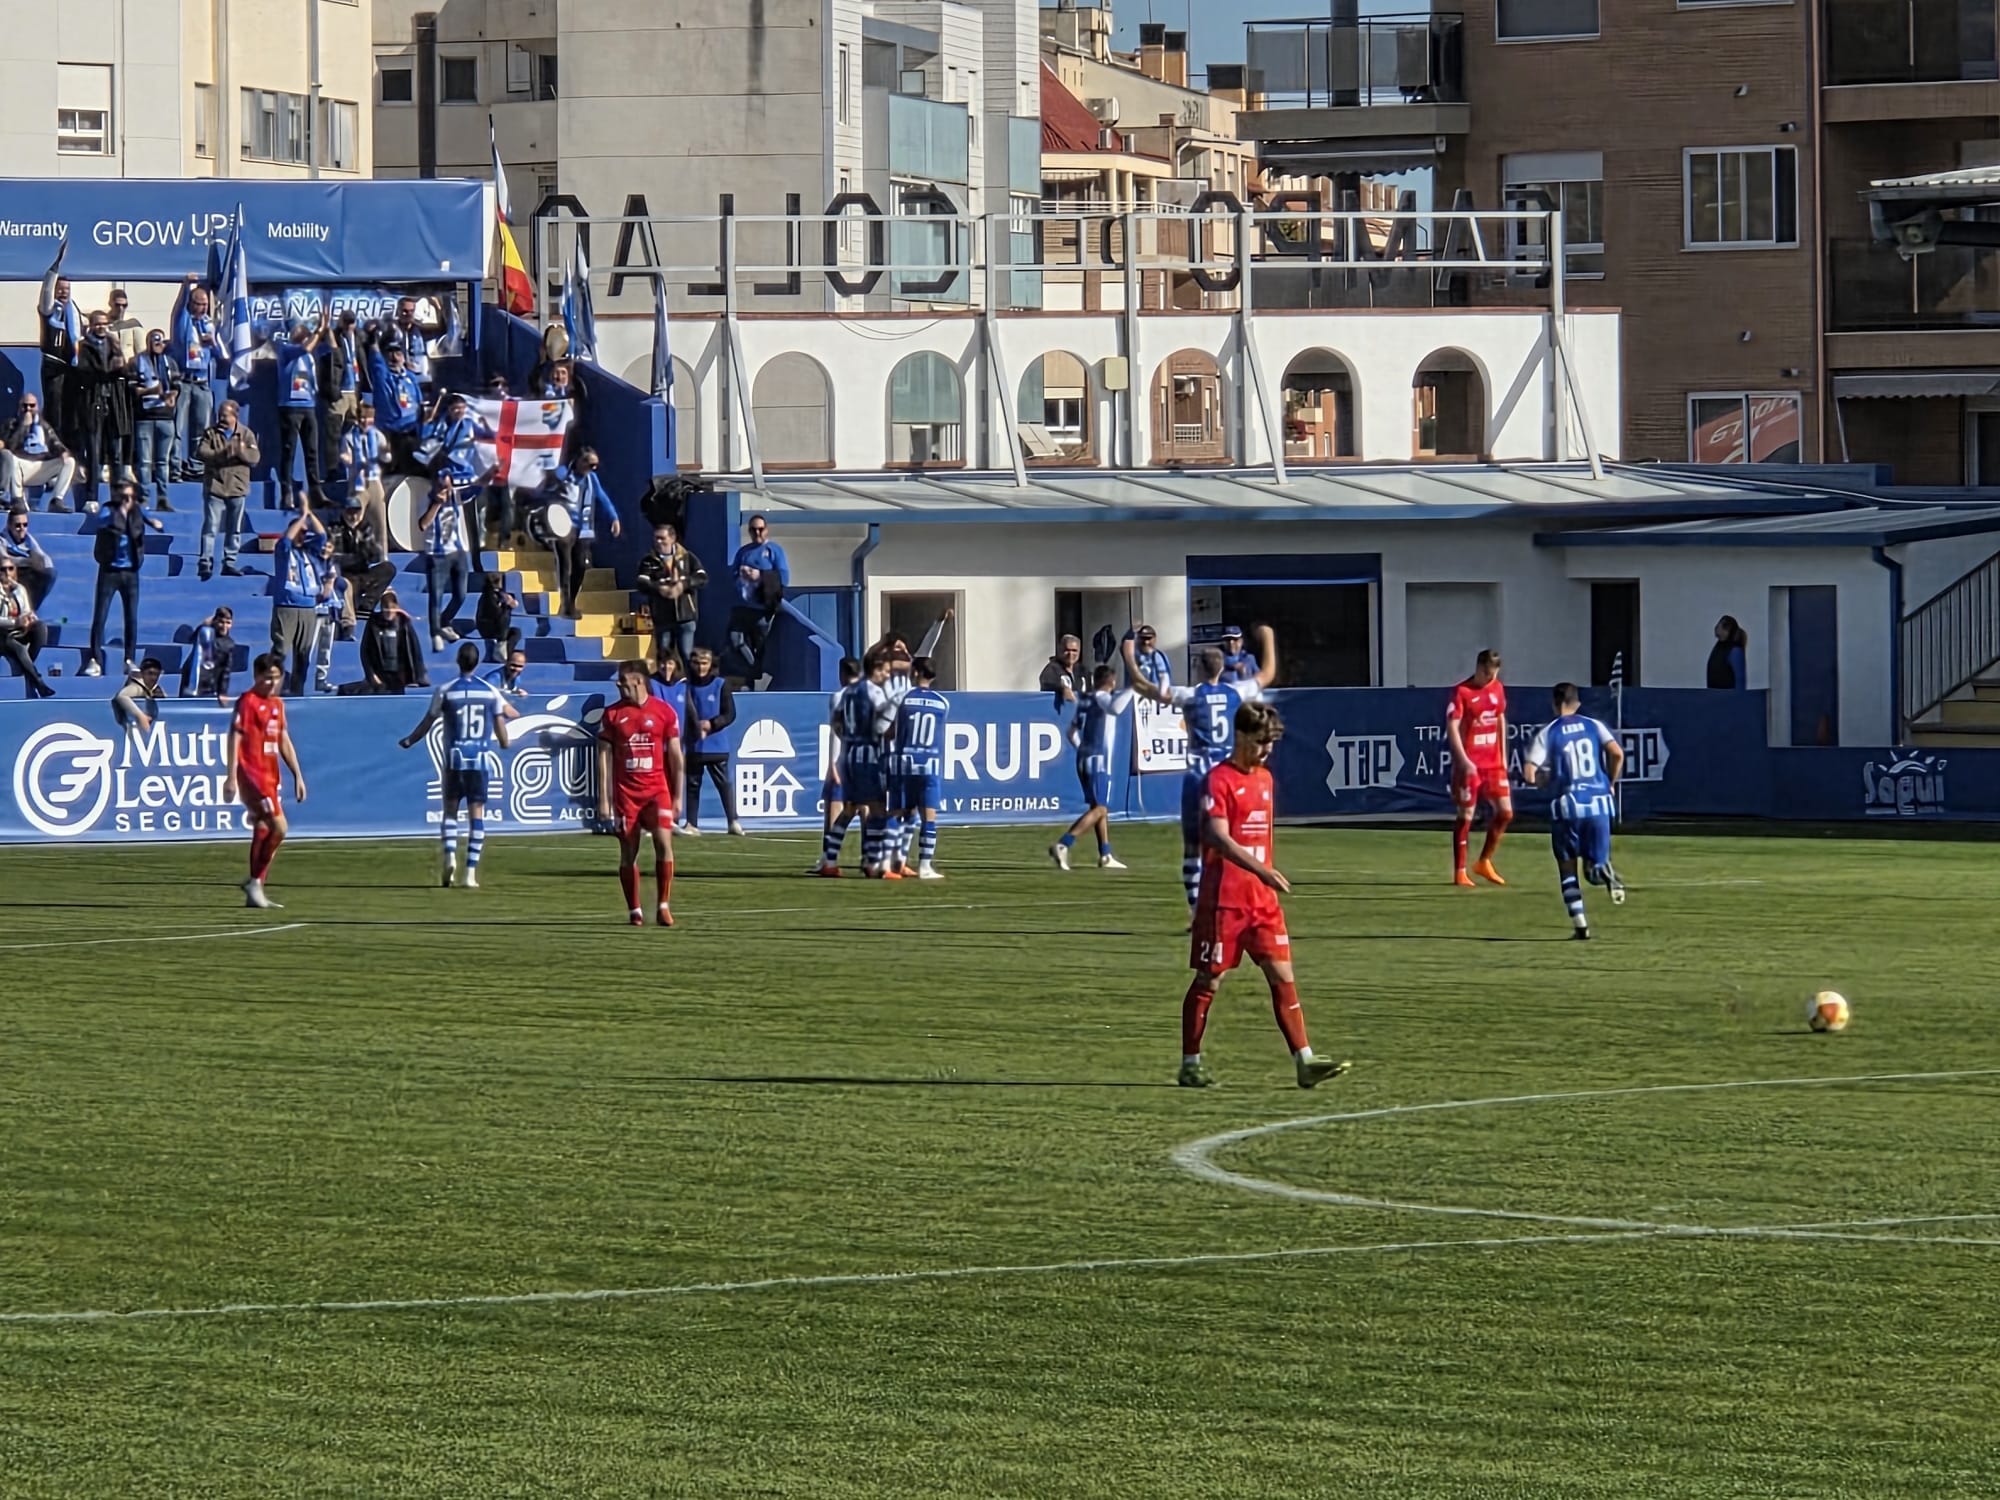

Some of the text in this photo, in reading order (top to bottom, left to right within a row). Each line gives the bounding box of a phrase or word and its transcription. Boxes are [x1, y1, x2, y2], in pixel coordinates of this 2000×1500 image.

[0, 220, 68, 239] Warranty
[92, 220, 184, 246] GROW
[267, 221, 330, 242] Mobility
[456, 704, 485, 739] 15
[908, 711, 936, 747] 10
[1210, 704, 1229, 744] 5
[119, 720, 228, 768] Mut
[1563, 738, 1596, 780] 18
[952, 798, 965, 812] Y
[970, 796, 1060, 813] REFORMAS
